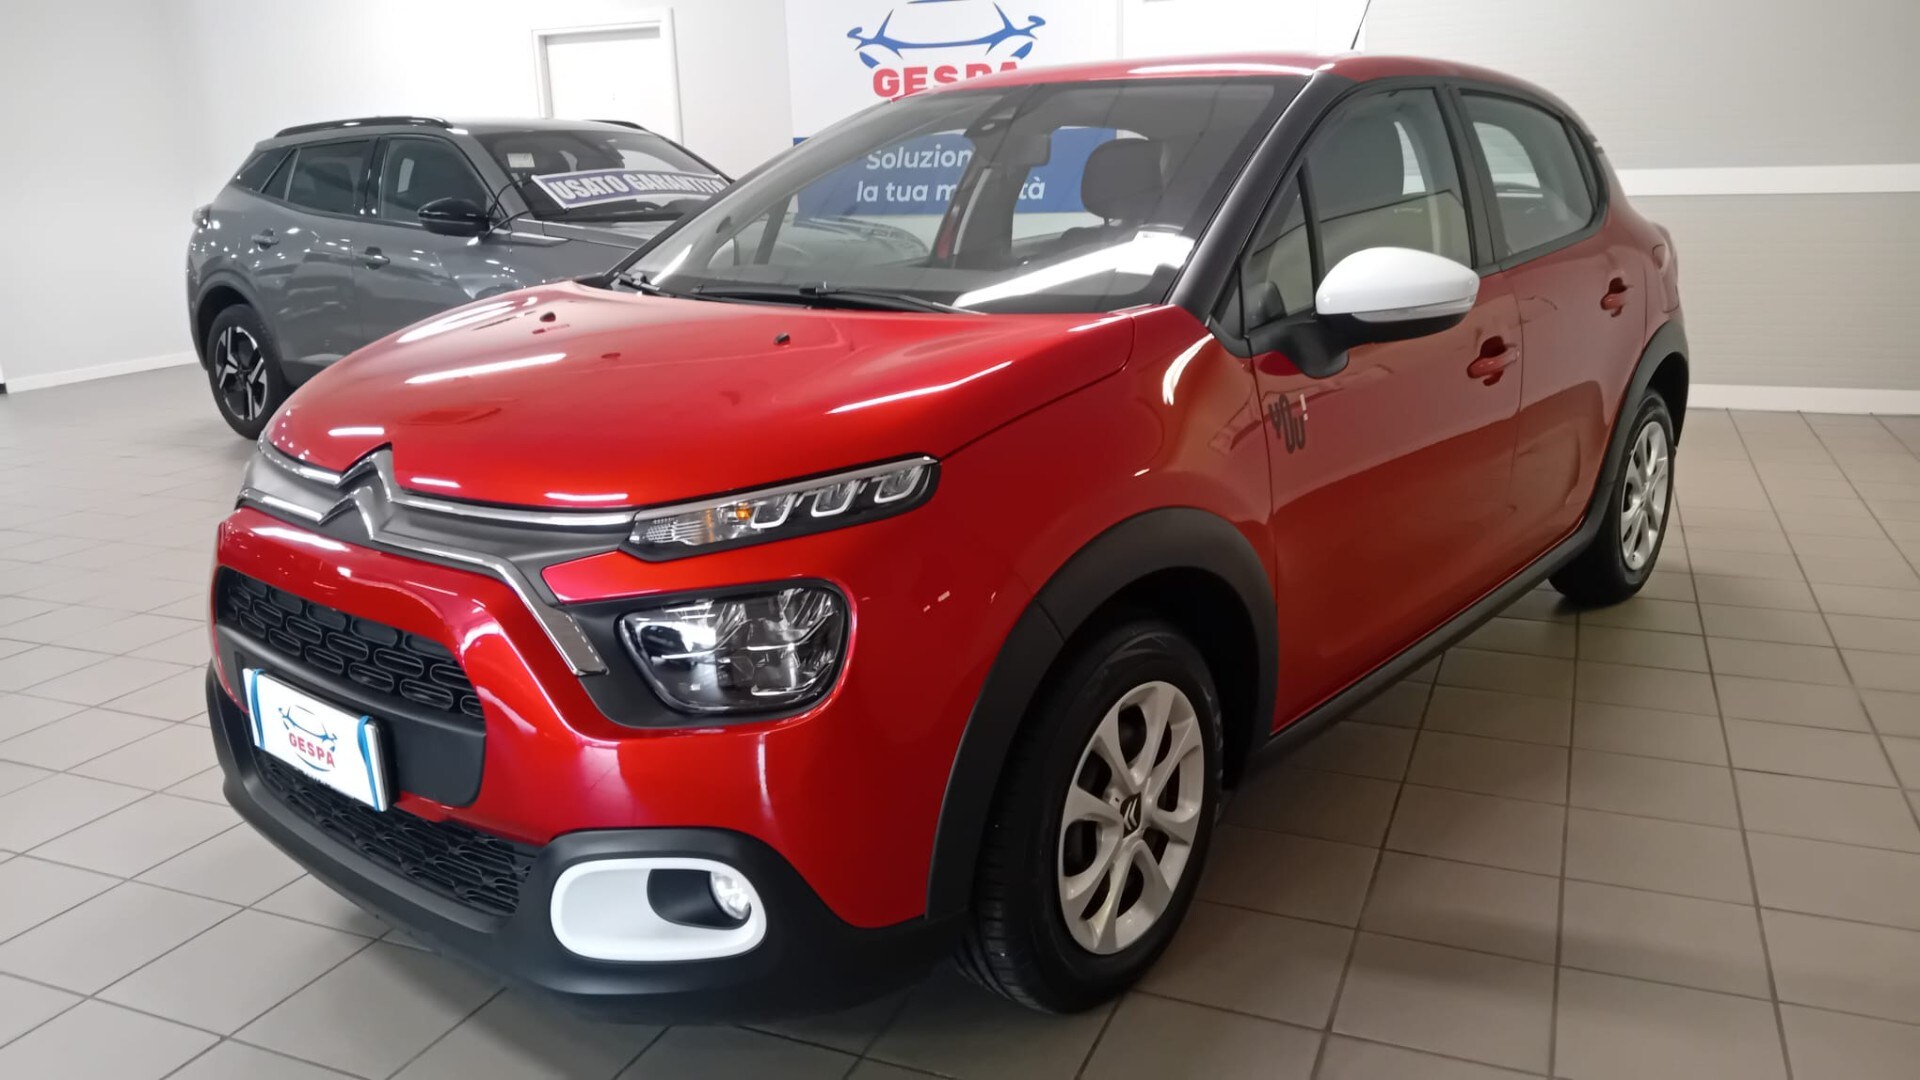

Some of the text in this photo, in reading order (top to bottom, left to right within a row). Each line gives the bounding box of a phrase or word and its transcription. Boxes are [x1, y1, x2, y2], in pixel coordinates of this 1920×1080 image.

[866, 144, 974, 169] Soluzion
[548, 175, 629, 200] USATO
[857, 181, 878, 202] la
[886, 182, 928, 202] tua
[289, 733, 335, 767] GESPA
